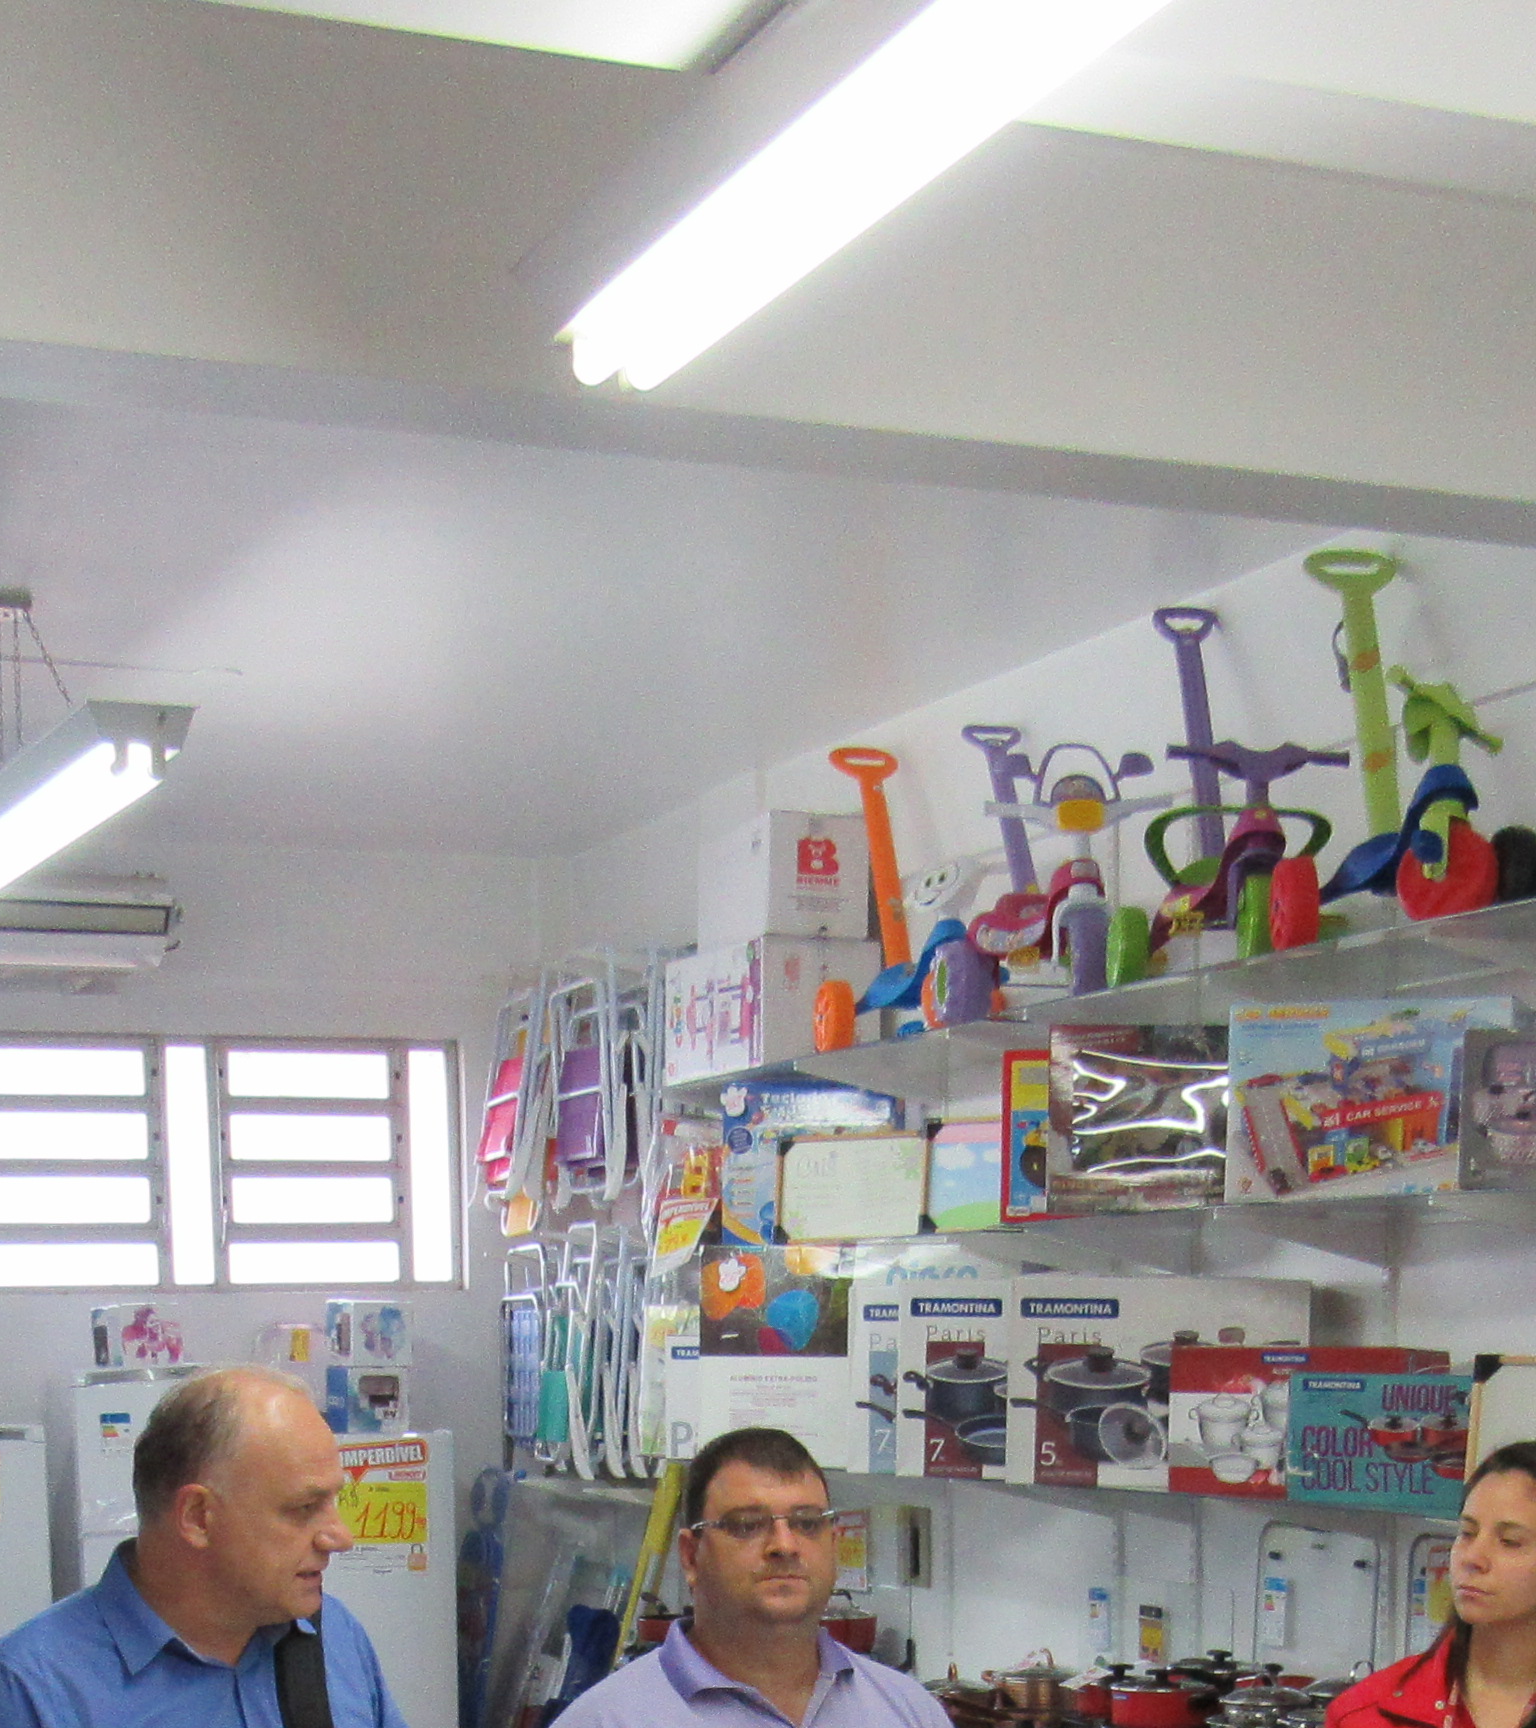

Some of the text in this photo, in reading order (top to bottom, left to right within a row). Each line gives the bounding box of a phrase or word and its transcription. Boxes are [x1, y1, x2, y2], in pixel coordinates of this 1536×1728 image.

[918, 1301, 997, 1314] TRAMONTINA
[1028, 1302, 1112, 1315] TRAMONTINA
[926, 1324, 986, 1342] Paris
[1037, 1326, 1102, 1344] Paris
[1381, 1383, 1458, 1415] UNIQUE
[929, 1438, 945, 1463] 7
[1040, 1441, 1057, 1466] 5
[1301, 1425, 1374, 1458] COLOR
[340, 1443, 424, 1468] IMPERDÍVEL
[1301, 1458, 1434, 1494] COOL STYLE
